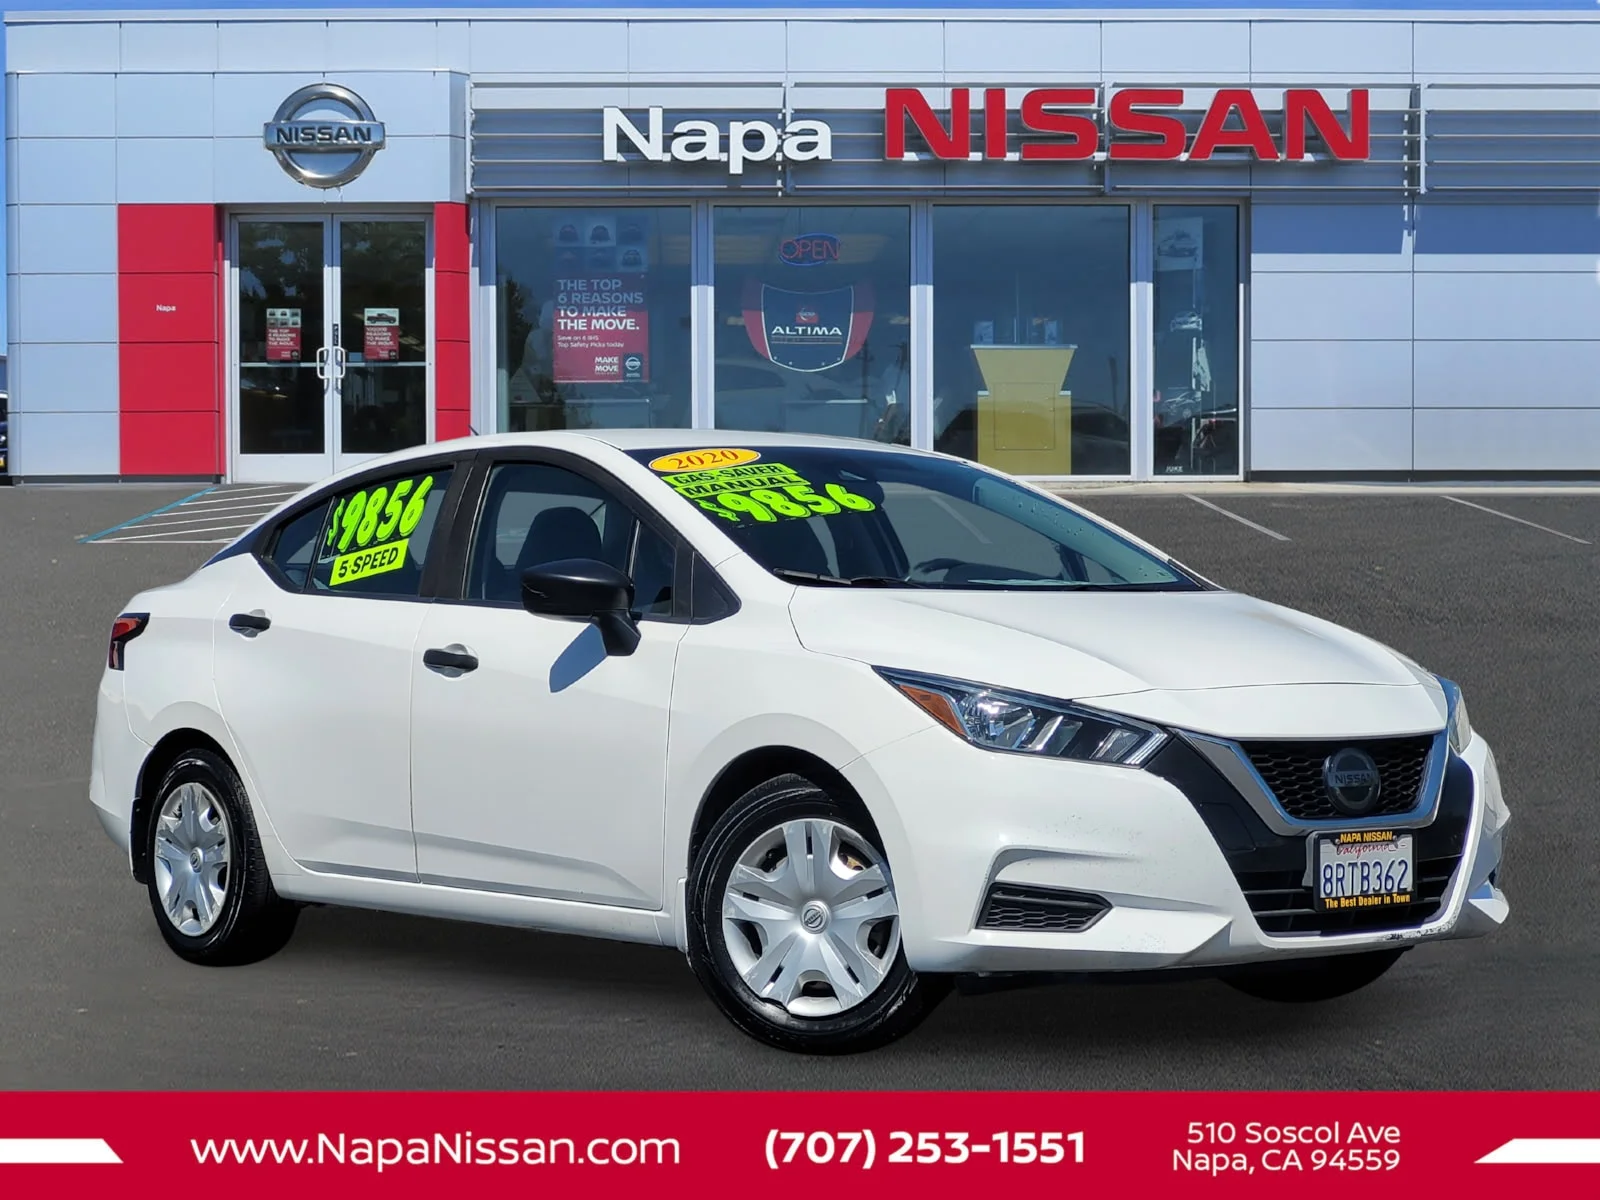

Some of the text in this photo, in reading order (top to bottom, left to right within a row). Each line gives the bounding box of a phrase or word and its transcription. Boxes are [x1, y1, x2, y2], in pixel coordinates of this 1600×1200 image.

[276, 126, 371, 143] NISSAN
[603, 87, 1369, 174] Napa NISSAN
[780, 239, 839, 259] OPEN
[557, 279, 622, 290] THE TOP
[557, 292, 643, 304] 6 REASONS
[156, 304, 177, 312] Napa
[557, 305, 626, 317] TO MAKE
[557, 318, 640, 330] THE MOVE.
[771, 326, 843, 336] ALTIMA
[669, 450, 739, 469] 2020
[686, 474, 803, 496] MANUAL
[695, 483, 875, 522] $9856
[327, 476, 433, 552] $9856
[1335, 773, 1373, 784] NISSAN
[1340, 831, 1393, 844] NAPA NISSAN
[1322, 859, 1409, 897] 8RTB362
[1325, 893, 1410, 908] The Best Dealer in Town
